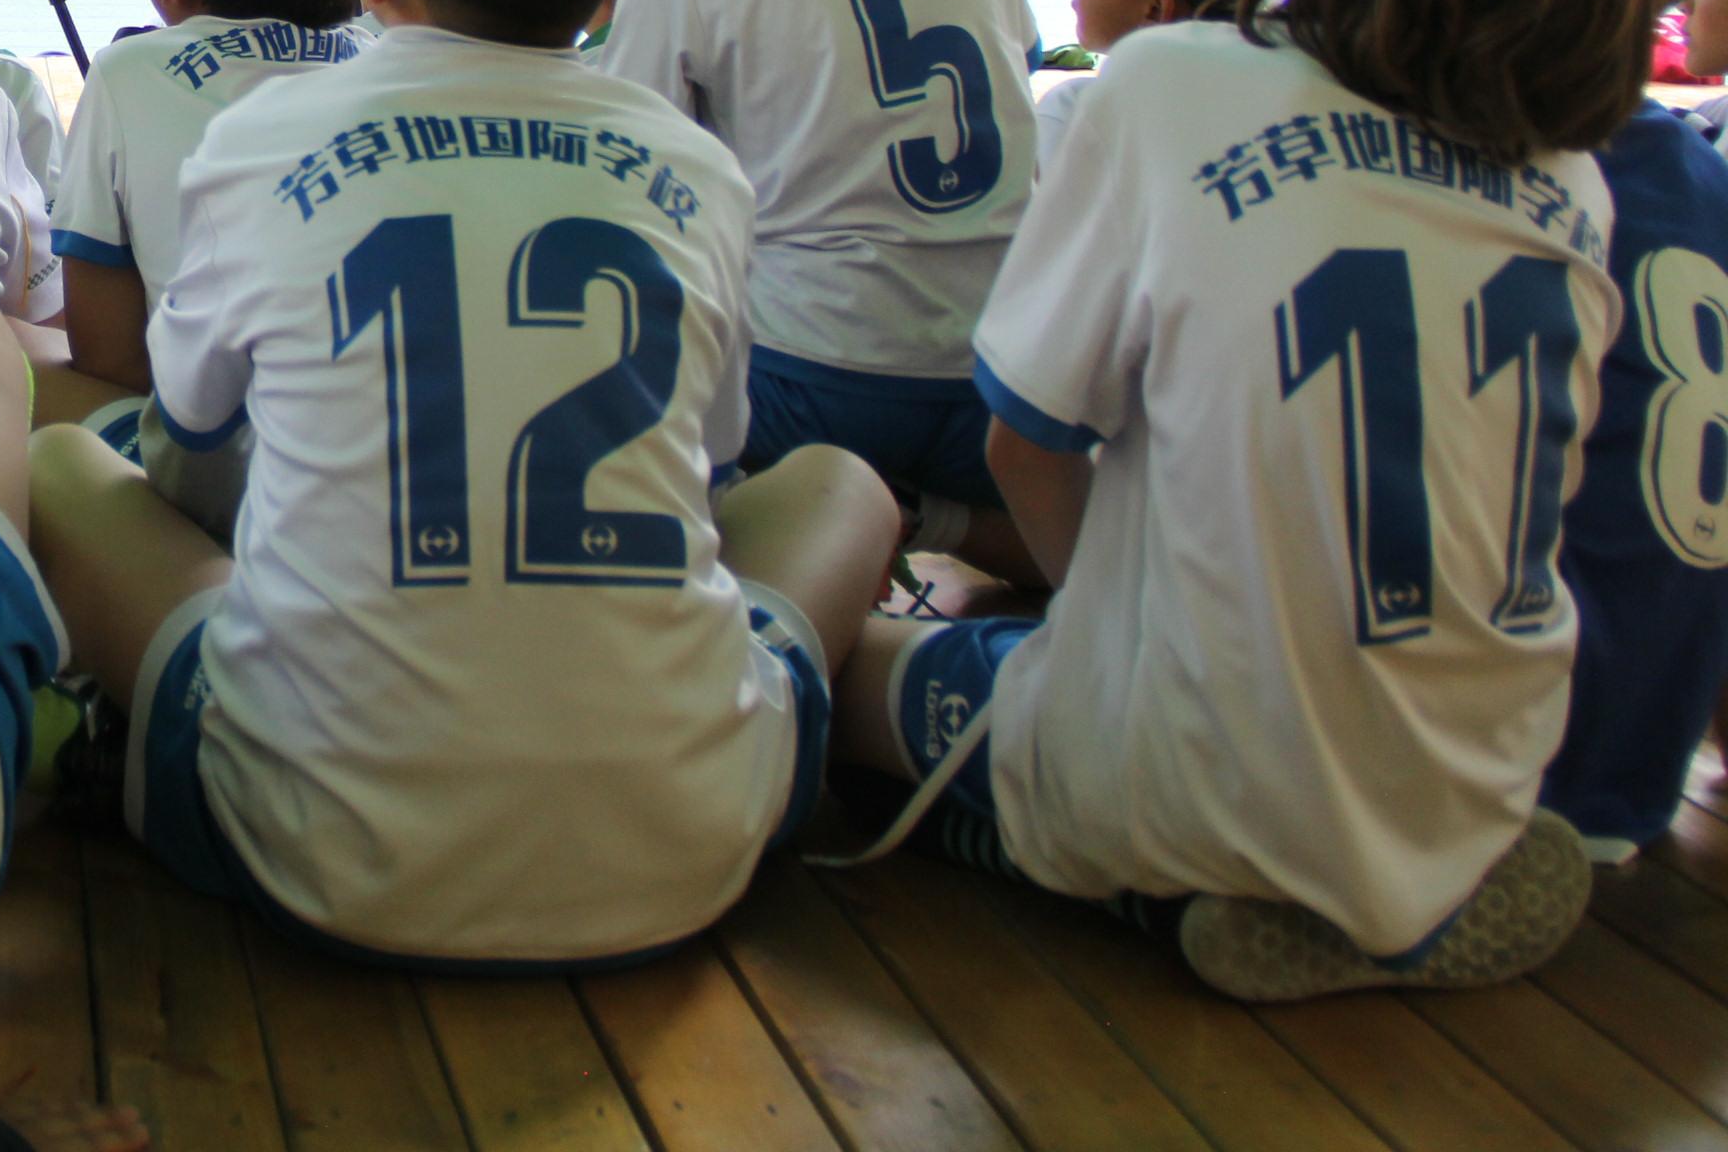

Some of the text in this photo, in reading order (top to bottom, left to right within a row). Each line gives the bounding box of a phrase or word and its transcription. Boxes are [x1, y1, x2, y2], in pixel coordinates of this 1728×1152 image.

[274, 115, 702, 234] 芳草地国际学校
[326, 214, 688, 589] 12
[1274, 249, 1581, 646] 11
